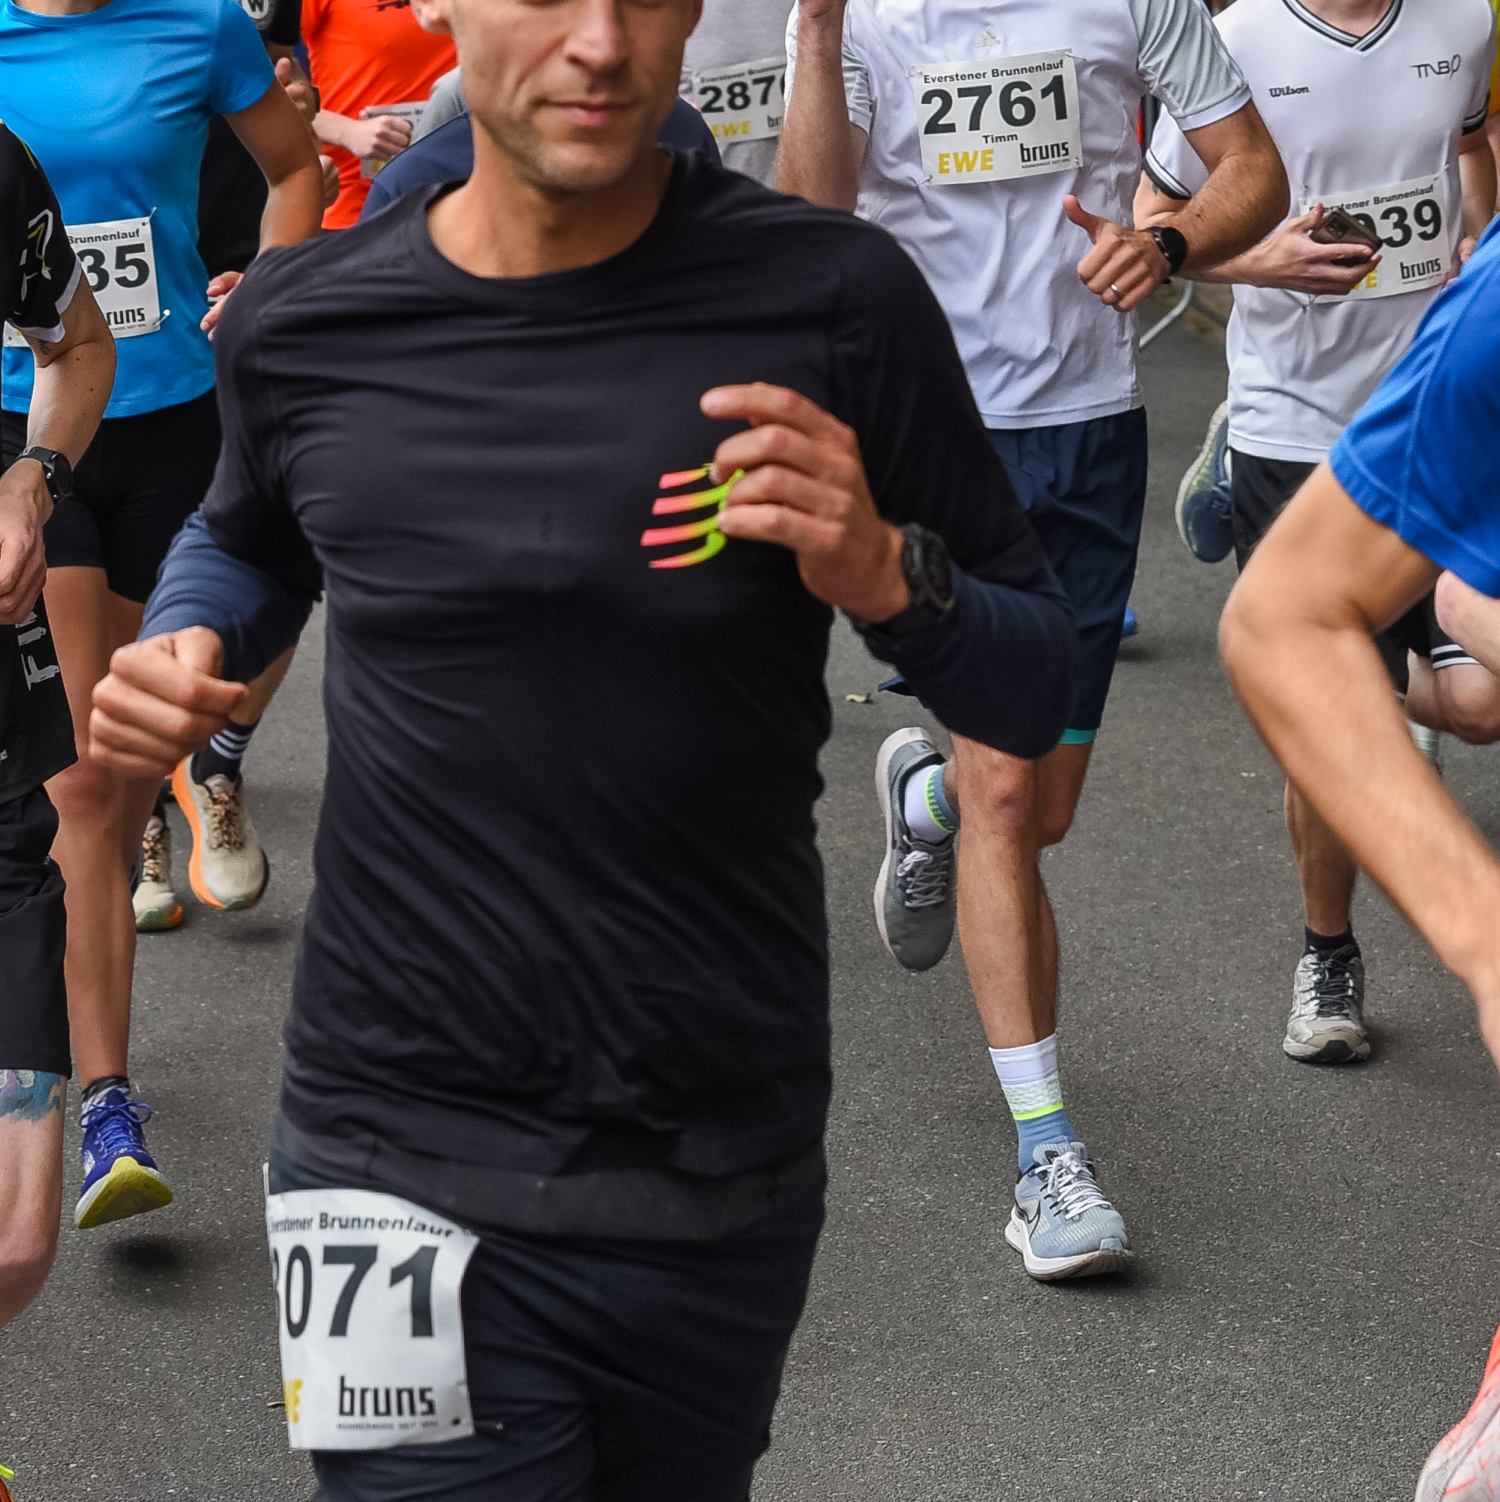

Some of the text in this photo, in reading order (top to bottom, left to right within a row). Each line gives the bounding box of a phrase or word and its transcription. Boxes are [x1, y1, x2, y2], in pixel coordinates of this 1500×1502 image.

[923, 59, 1065, 84] Everstener Brunnenlauf
[699, 74, 786, 114] 287
[1268, 84, 1311, 98] Wilson
[920, 73, 1069, 135] 2761
[711, 120, 750, 138] EWE
[982, 133, 1019, 145] Timm
[938, 141, 1070, 175] EWE bruns
[1373, 184, 1434, 205] Brunnenlauf
[68, 228, 140, 245] Brunnenlauf
[1399, 257, 1442, 280] bruns
[106, 307, 145, 326] runs
[273, 1244, 440, 1339] 071
[338, 1374, 437, 1418] bruns
